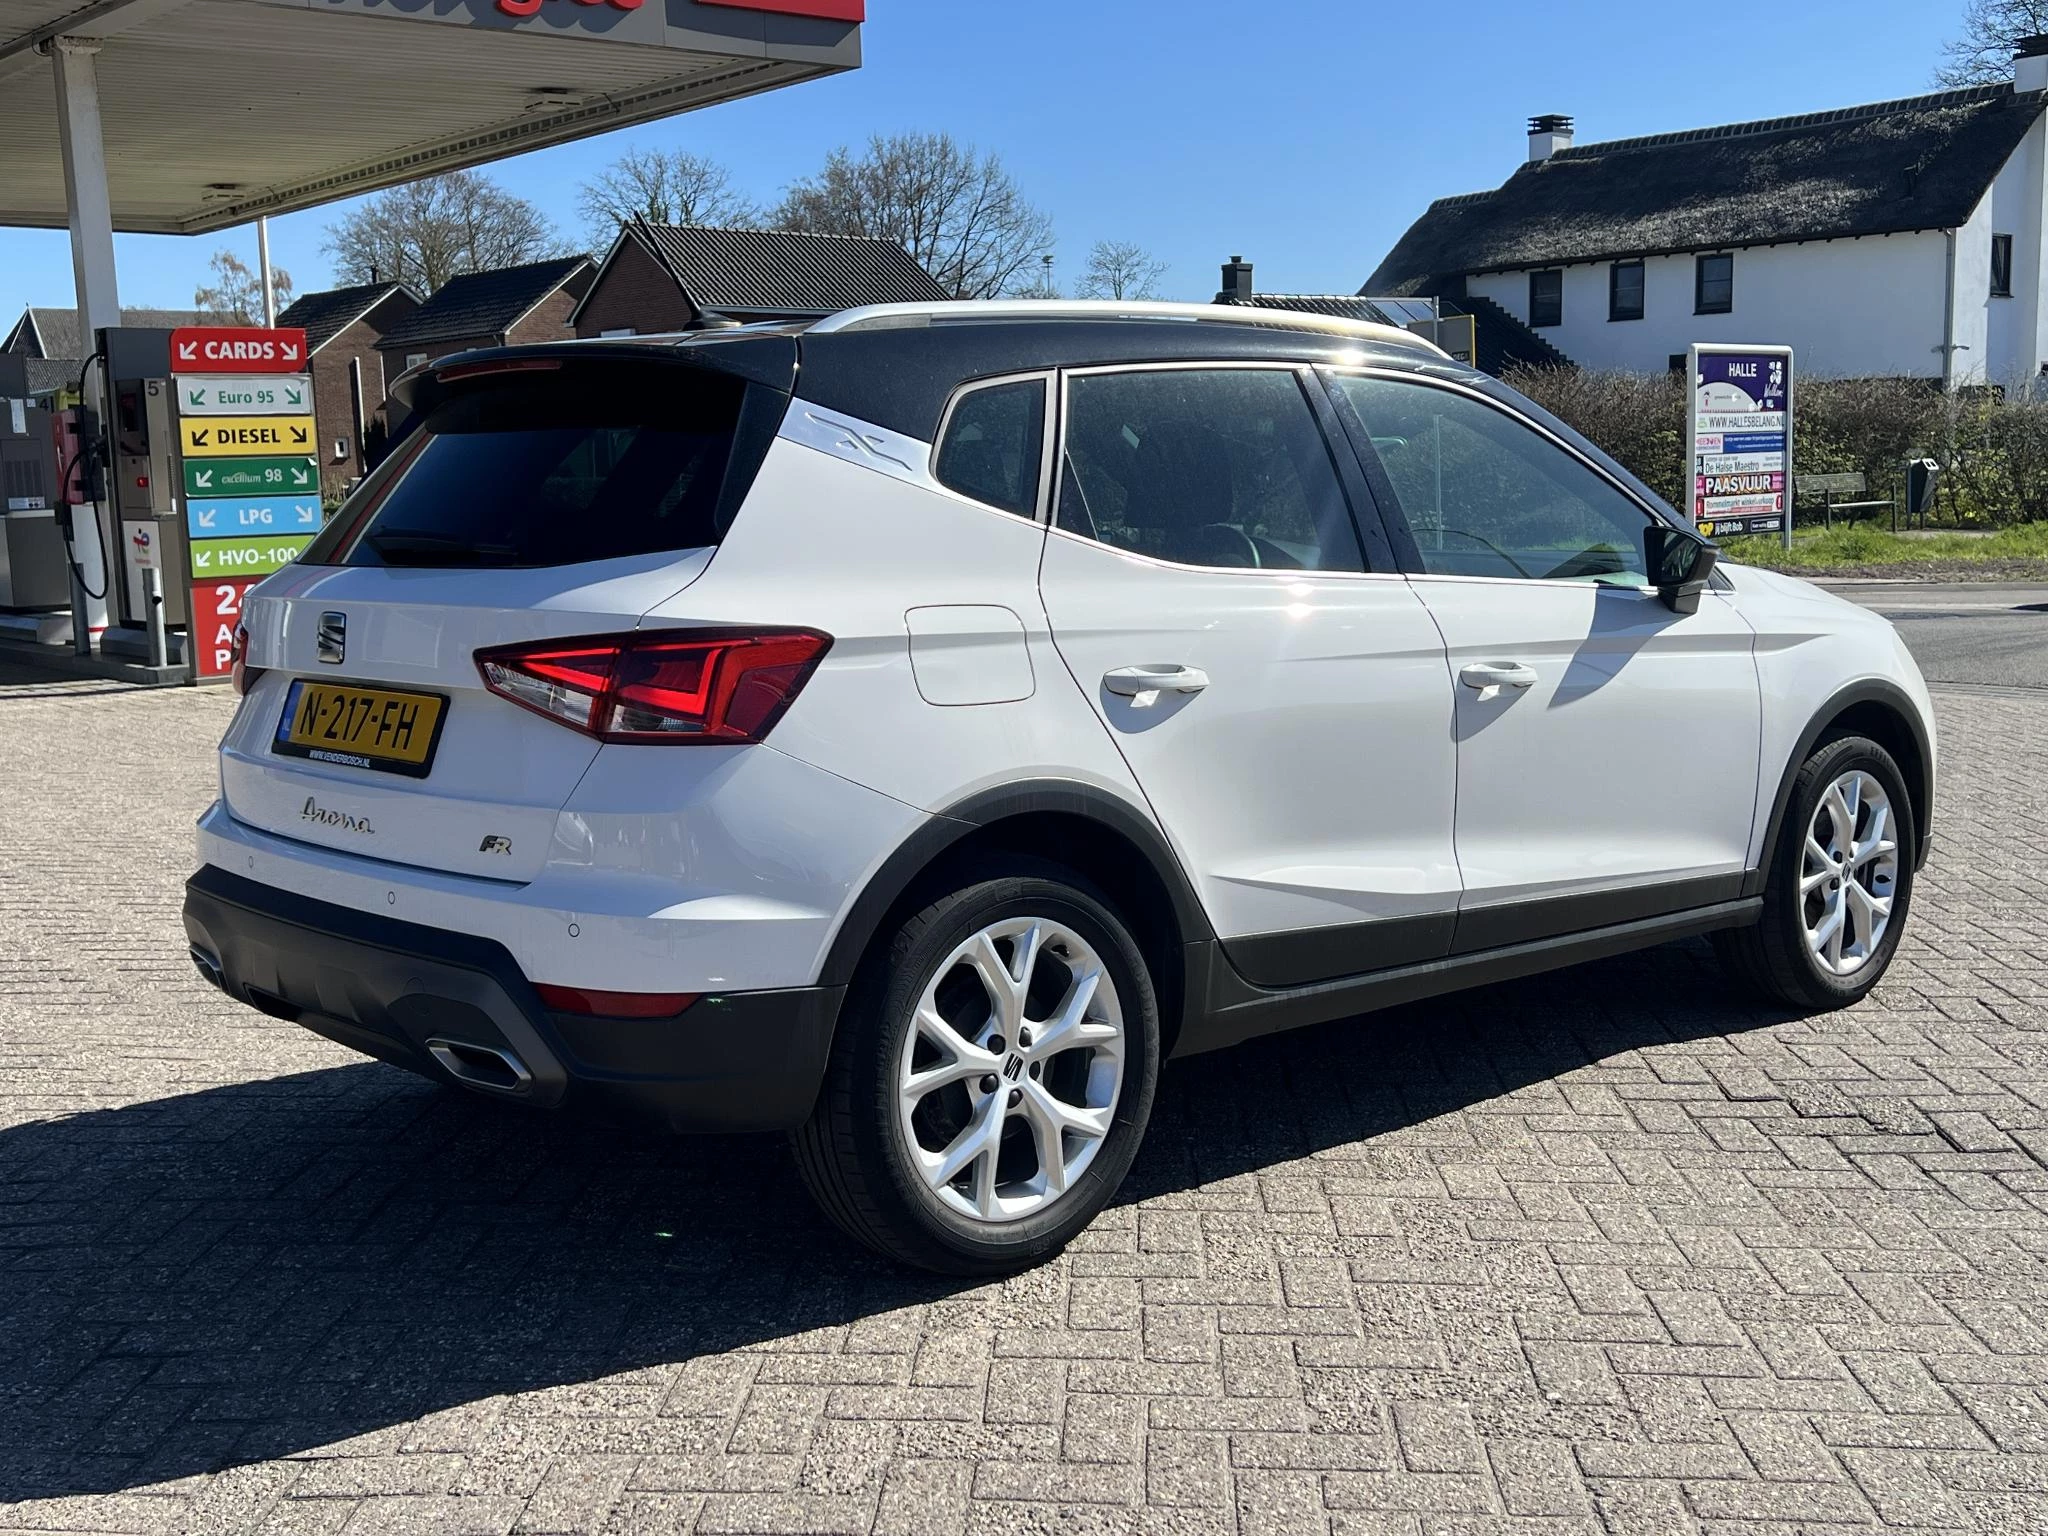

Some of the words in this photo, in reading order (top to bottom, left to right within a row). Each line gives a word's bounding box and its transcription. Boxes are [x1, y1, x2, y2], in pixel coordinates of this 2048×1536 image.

[204, 341, 275, 360] CARDS
[1728, 362, 1757, 377] HALLE
[148, 380, 159, 397] 5
[218, 390, 252, 404] Euro
[257, 390, 274, 404] 95
[39, 398, 49, 411] 4
[1708, 415, 1784, 429] WWW.HALLESBELANG.NL
[217, 428, 281, 444] DIESEL
[1734, 460, 1760, 472] Maestro
[264, 468, 283, 482] 98
[1705, 474, 1771, 493] PAASVUUR
[239, 508, 273, 525] LPG
[218, 547, 299, 566] HVO-100
[215, 584, 256, 615] 2
[298, 691, 419, 750] N-217-FH
[300, 796, 375, 834] Arona
[479, 834, 512, 855] FR
